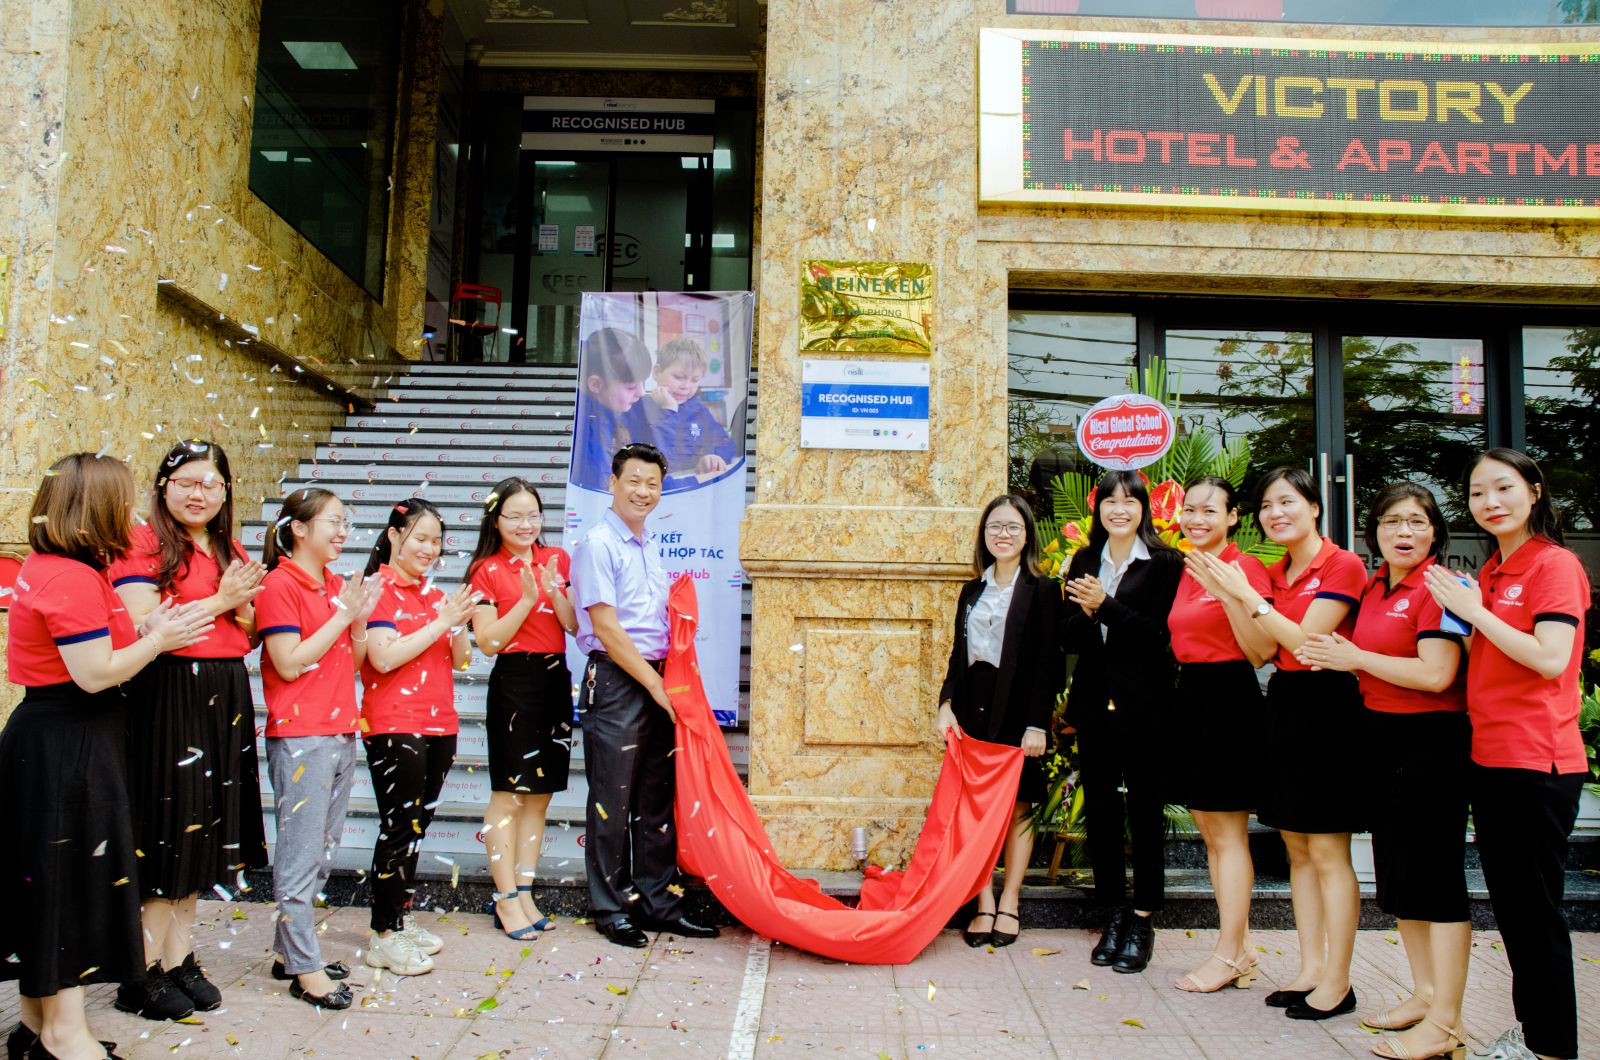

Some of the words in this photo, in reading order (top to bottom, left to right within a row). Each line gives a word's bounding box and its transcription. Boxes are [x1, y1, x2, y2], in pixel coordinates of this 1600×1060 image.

[1203, 73, 1534, 123] VICTORY
[552, 117, 650, 130] RECOGNISED
[653, 118, 686, 130] HUB
[1063, 128, 1256, 167] HOTEL
[1269, 136, 1312, 169] &
[819, 276, 925, 295] HEINEKEN
[818, 393, 888, 405] RECOGNISED
[890, 394, 913, 405] HUB
[1089, 417, 1109, 435] Nisai
[1110, 415, 1134, 434] Global
[1136, 413, 1163, 431] School
[1089, 432, 1163, 453] Congratulation
[661, 531, 683, 544] KẾT
[668, 547, 696, 561] HỢP
[700, 546, 724, 561] TÁC
[684, 568, 710, 580] Hub
